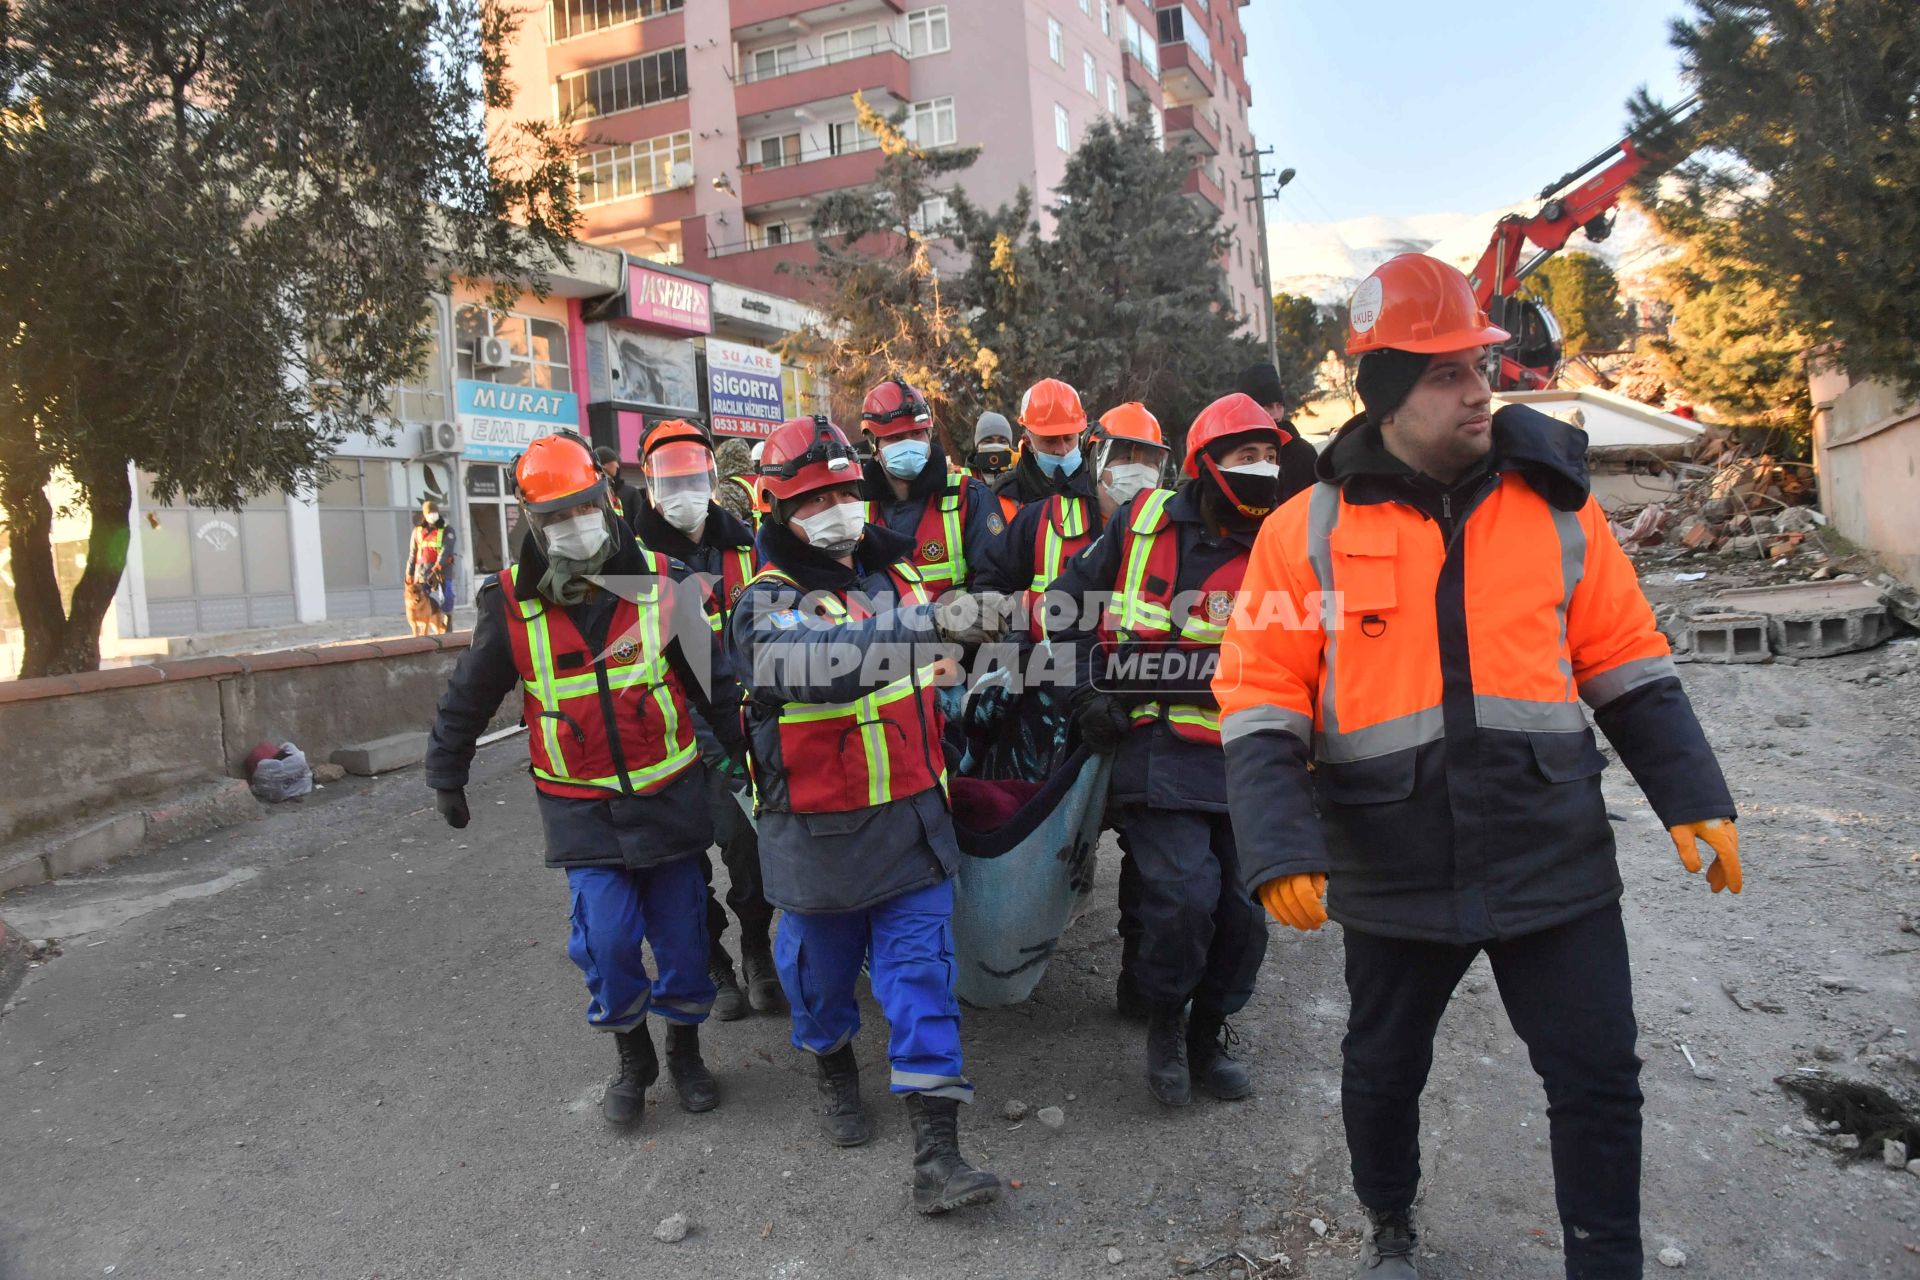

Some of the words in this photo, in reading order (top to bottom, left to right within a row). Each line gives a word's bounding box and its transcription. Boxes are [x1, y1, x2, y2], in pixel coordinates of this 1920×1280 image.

[721, 350, 772, 368] SUARE
[713, 371, 778, 401] SİGORTA
[473, 388, 562, 415] MURAT
[713, 398, 744, 415] ARACILIK
[745, 400, 781, 420] HİZMETLERİ
[472, 418, 561, 444] EMLA
[714, 418, 738, 432] 0533
[758, 422, 770, 434] 70
